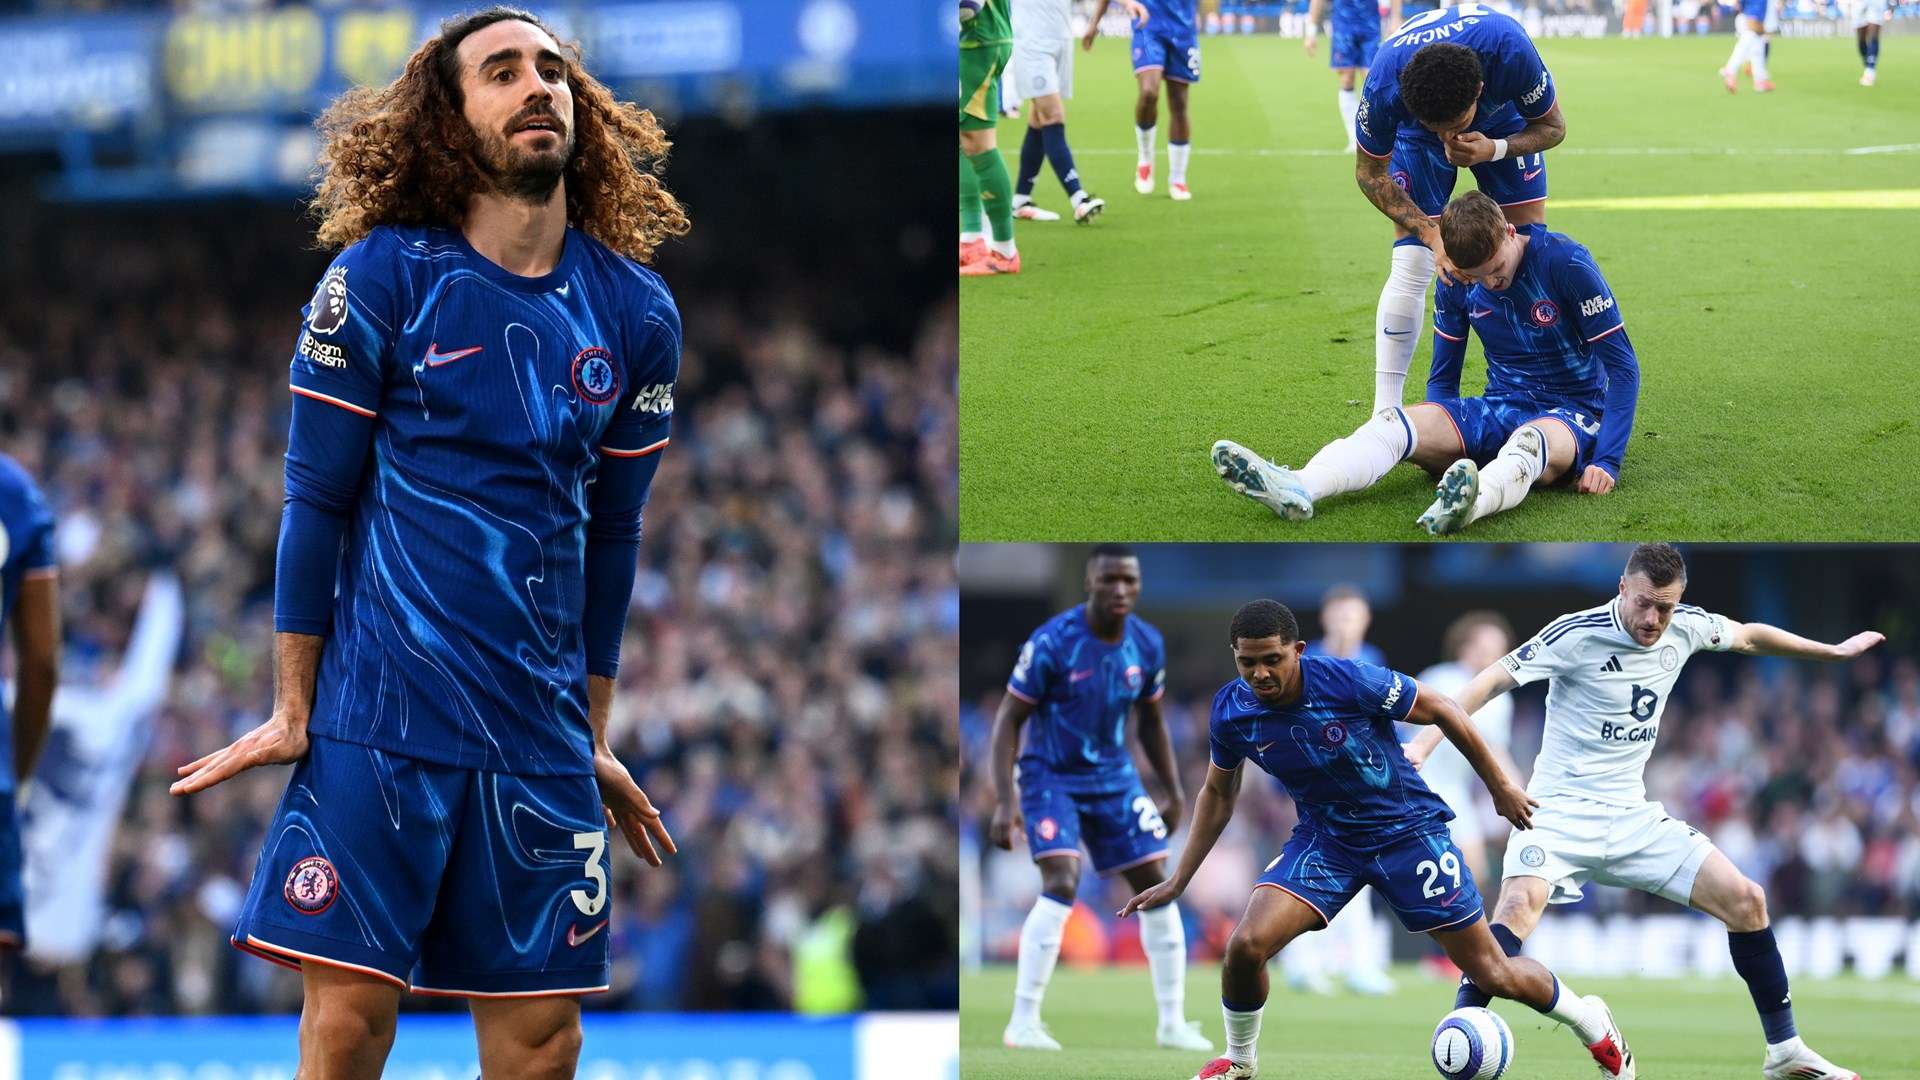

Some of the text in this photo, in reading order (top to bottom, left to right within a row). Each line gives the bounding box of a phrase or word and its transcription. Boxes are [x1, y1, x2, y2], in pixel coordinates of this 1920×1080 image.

[1392, 17, 1480, 48] SANCHO
[1581, 295, 1603, 308] LIVE
[1582, 297, 1615, 317] NATION
[571, 831, 608, 916] 3
[1416, 851, 1461, 899] 29
